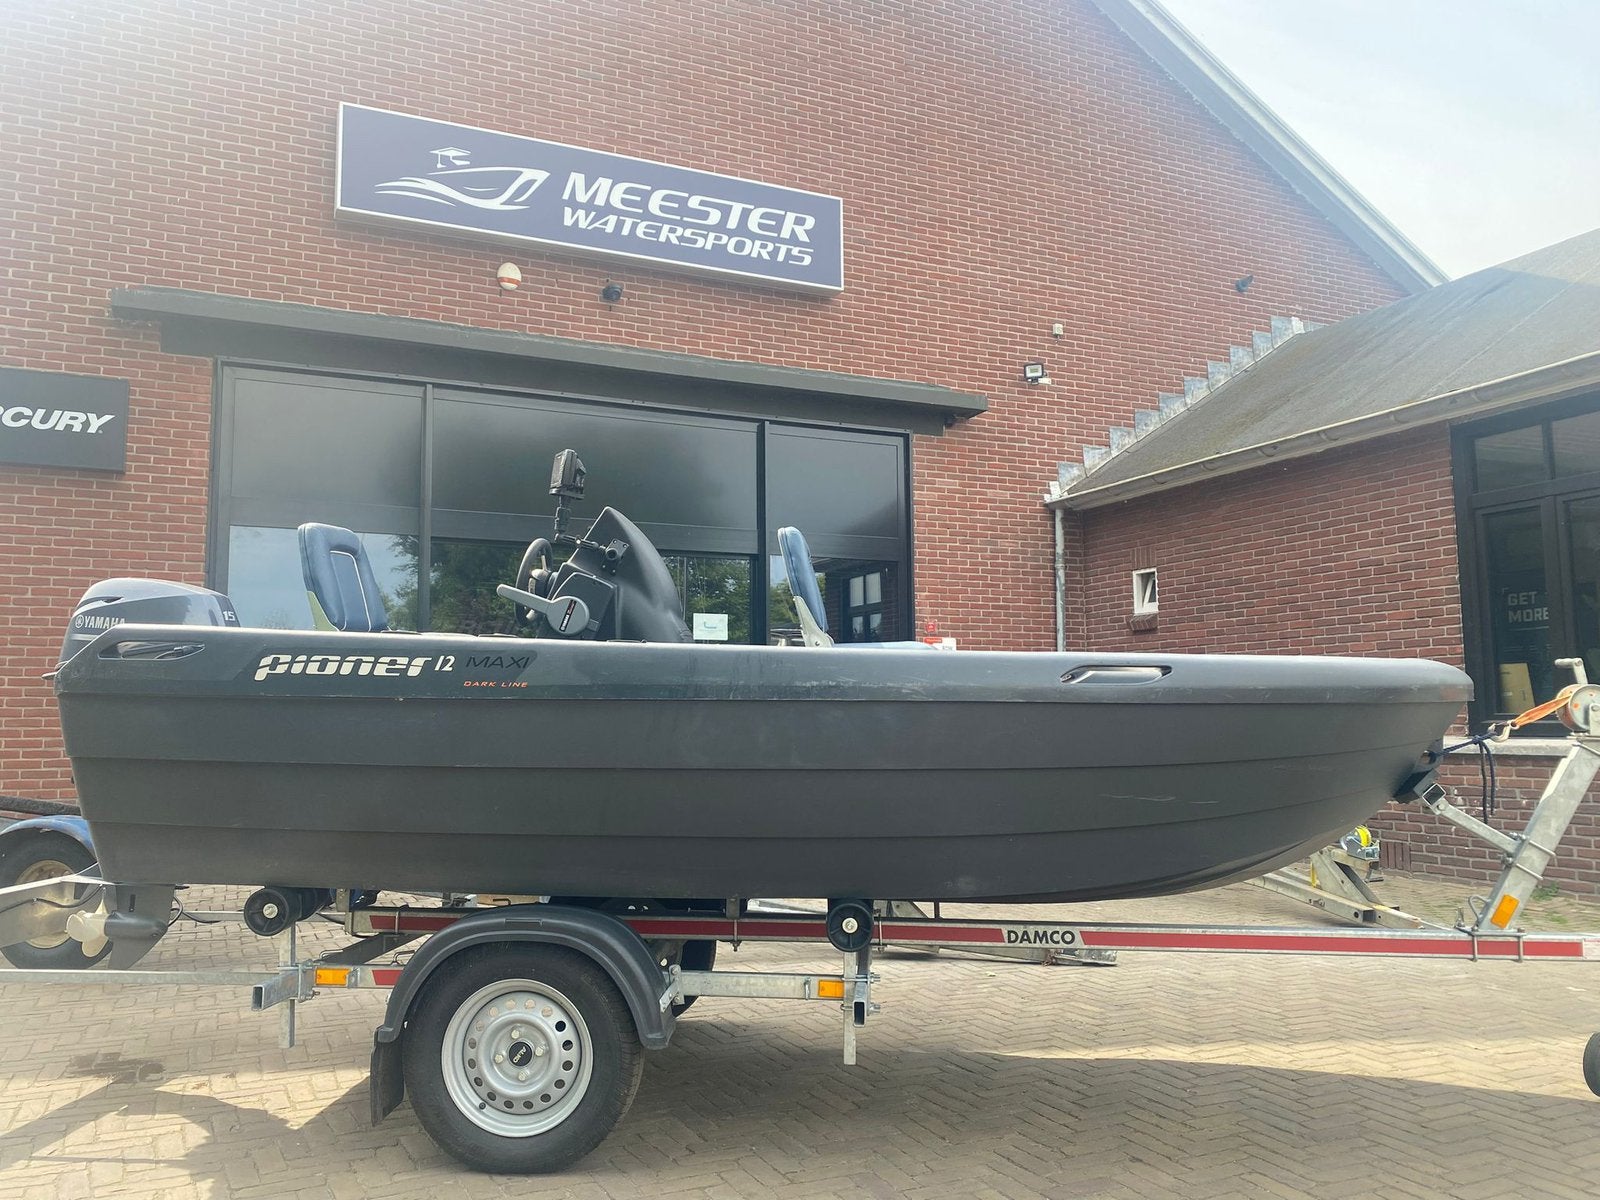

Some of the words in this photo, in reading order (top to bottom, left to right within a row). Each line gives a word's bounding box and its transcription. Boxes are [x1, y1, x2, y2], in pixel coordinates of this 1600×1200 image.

[562, 172, 816, 243] MEESTER
[563, 207, 815, 266] WATERSPORTS
[0, 405, 116, 434] CURY
[1508, 591, 1538, 606] GET
[222, 611, 236, 622] 15
[1508, 607, 1550, 624] MORE
[434, 655, 456, 671] 12
[465, 656, 530, 669] MAXI
[1006, 930, 1076, 945] DAMCO
